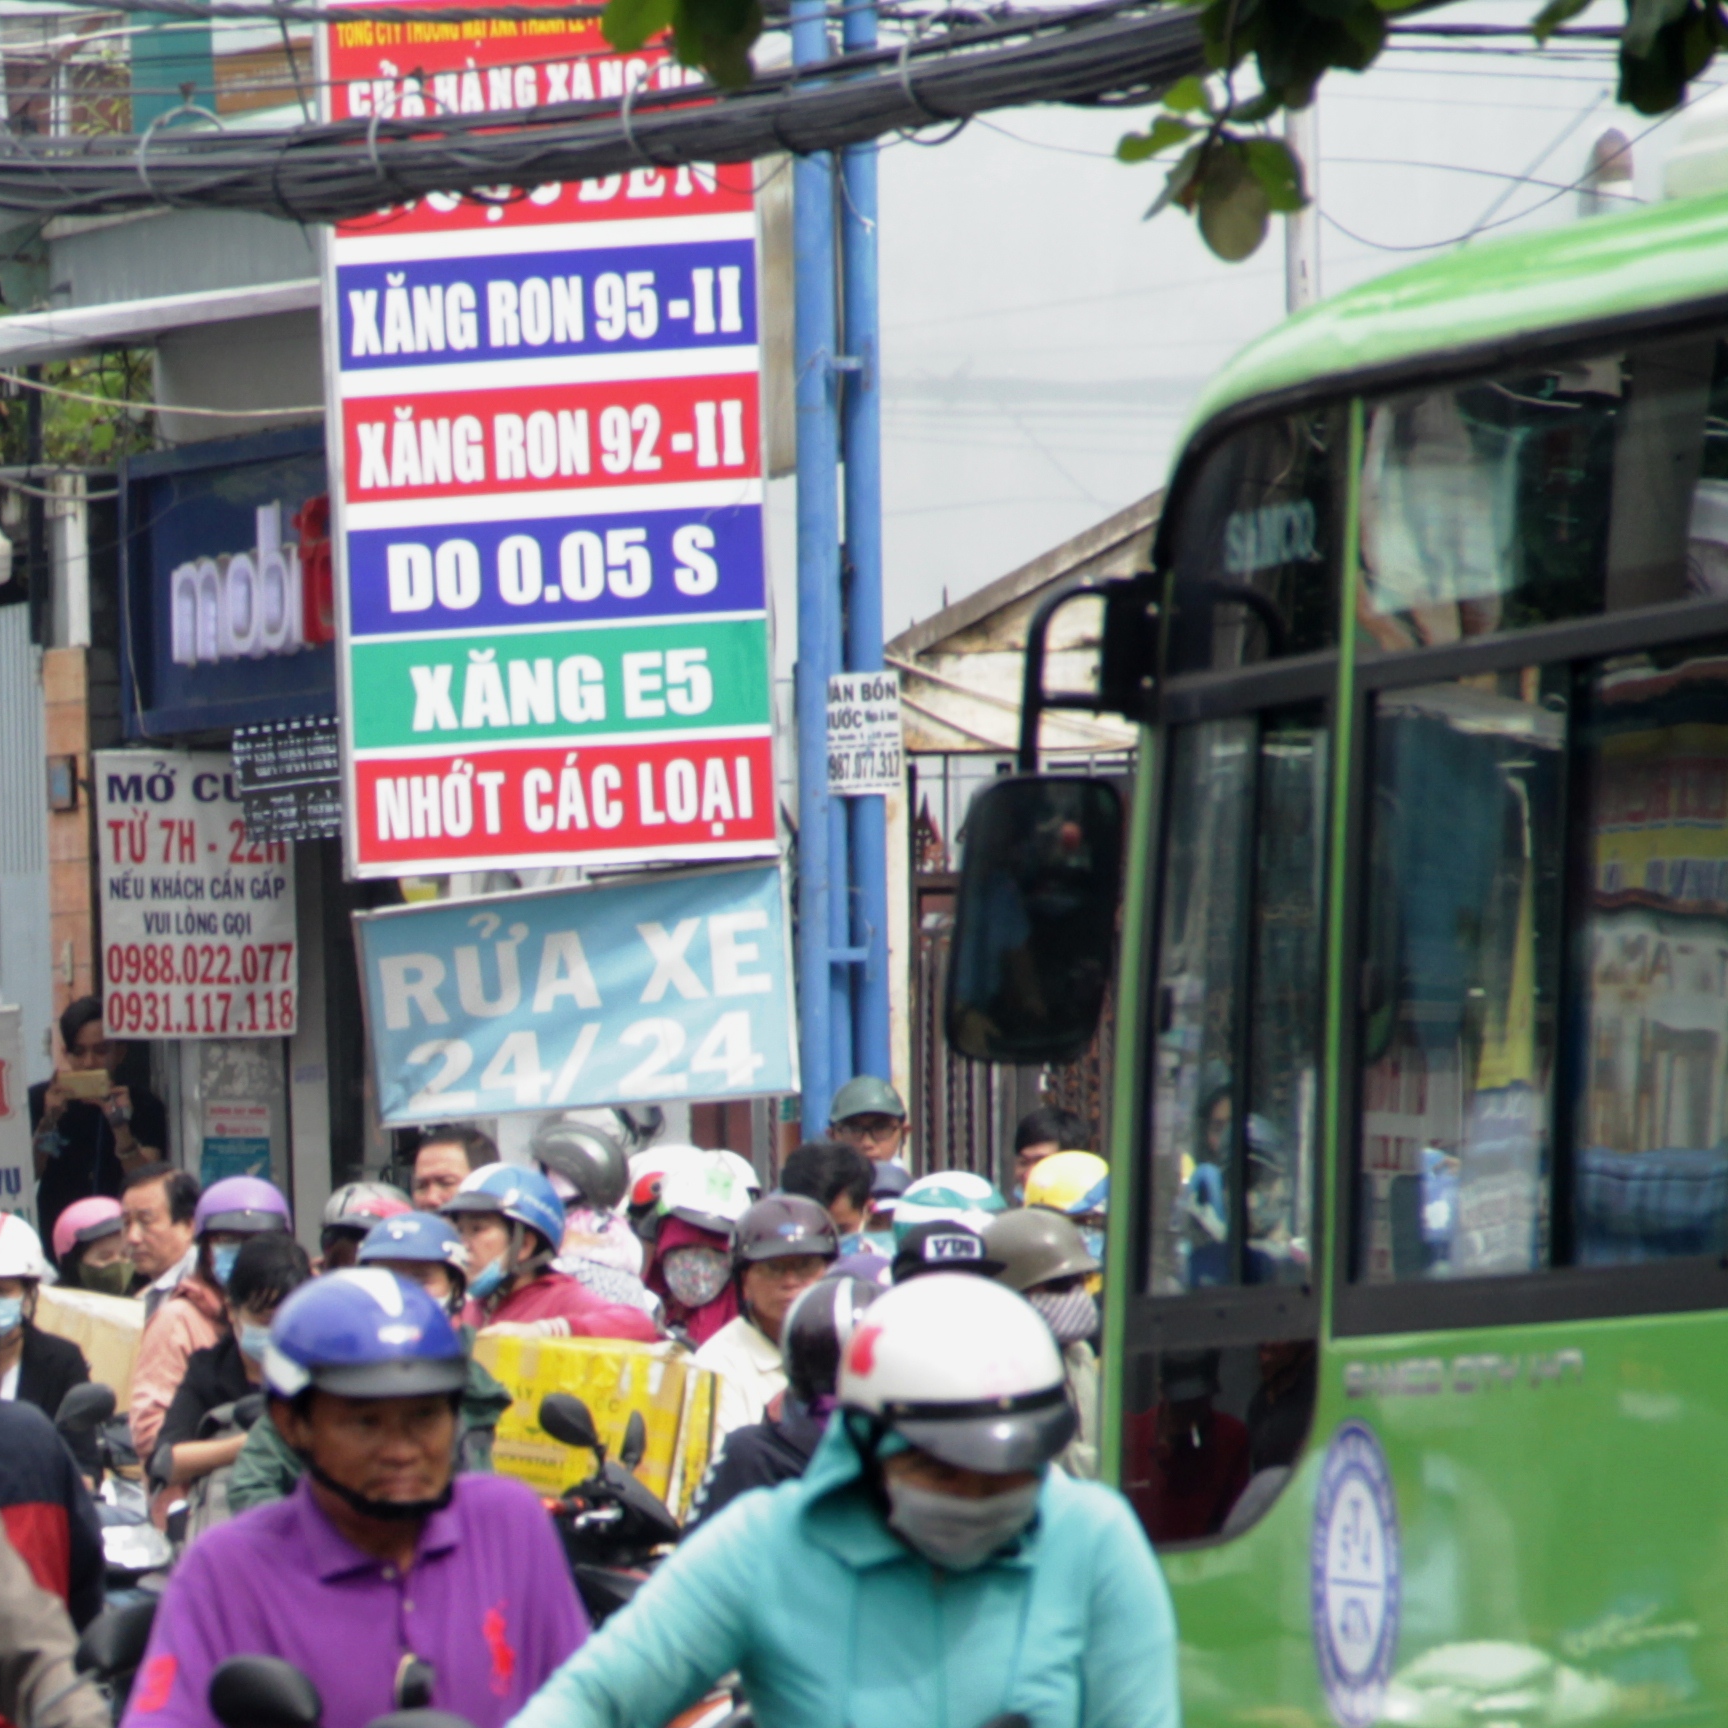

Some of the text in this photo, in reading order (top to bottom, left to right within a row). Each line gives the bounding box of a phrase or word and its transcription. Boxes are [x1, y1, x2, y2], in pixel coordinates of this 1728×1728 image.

[349, 272, 479, 356] XĂNG
[487, 275, 585, 348] RON
[594, 271, 659, 341] 95
[357, 405, 486, 489] XĂNG
[494, 408, 591, 481] RON
[599, 403, 663, 474] 92
[387, 523, 719, 614] DO 0.05 S
[409, 647, 714, 732] XĂNG E5
[106, 762, 176, 803] MỞ
[375, 758, 505, 842] NHỚT
[522, 752, 624, 833] CÁC
[638, 756, 753, 837] LOẠI
[106, 807, 150, 864] TỪ
[159, 820, 197, 864] 7H
[109, 867, 145, 900] NẾU
[150, 869, 205, 900] KHÁCH
[250, 867, 286, 899] GẤP
[144, 905, 252, 940] VUI LÒNG GỌI
[106, 942, 294, 985] 0988.022.077
[378, 909, 773, 1031] RỬA XE
[106, 990, 294, 1034] 0931.117.118
